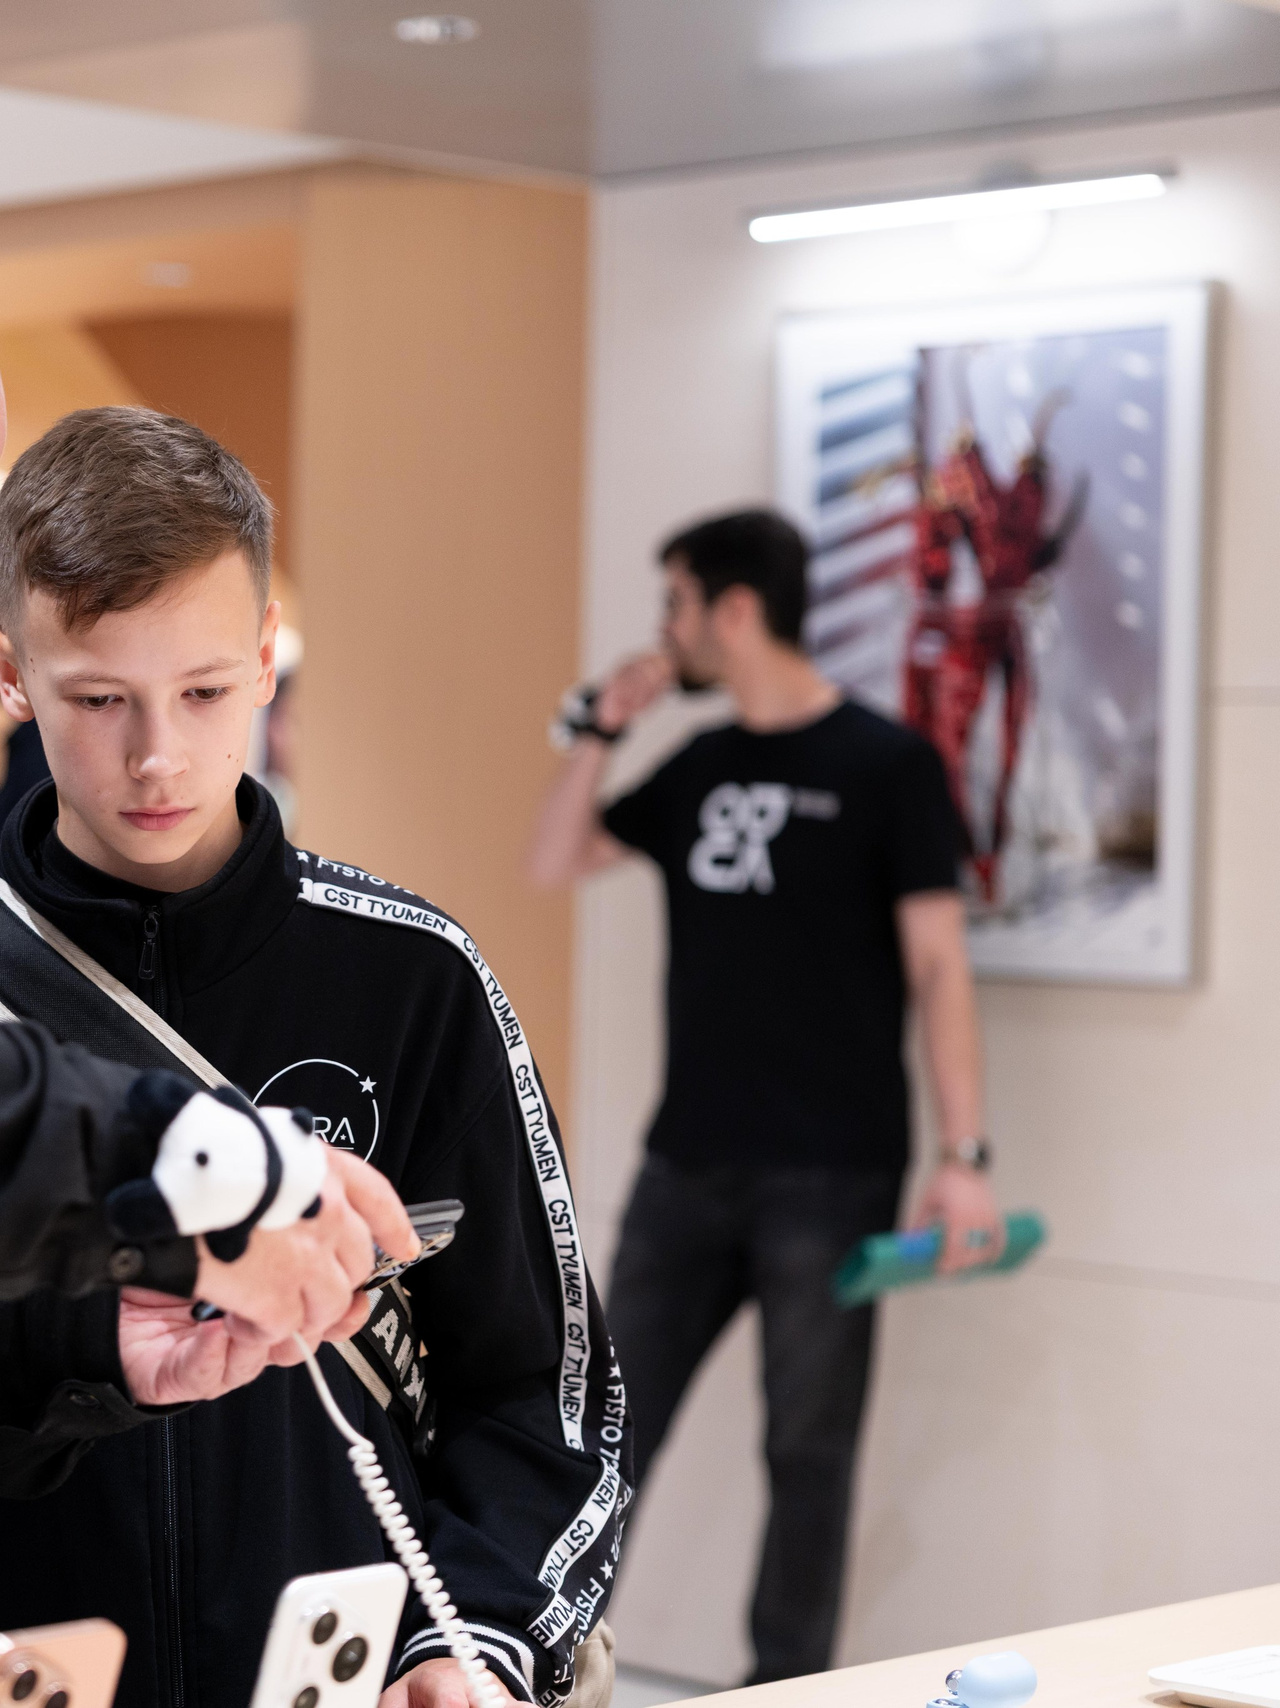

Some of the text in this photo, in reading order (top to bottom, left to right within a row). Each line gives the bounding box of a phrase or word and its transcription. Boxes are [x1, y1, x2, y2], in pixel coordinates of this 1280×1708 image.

[317, 856, 387, 886] FTSTO
[323, 888, 363, 910] CST
[367, 899, 448, 933] TYUMEN
[463, 937, 524, 1050] CST TYUMEN
[514, 1064, 561, 1183] CST TYUMEN
[548, 1199, 585, 1311] CST TYUMEN
[567, 1322, 586, 1357] CST
[600, 1383, 626, 1443] FTSTO
[563, 1518, 595, 1558] CST
